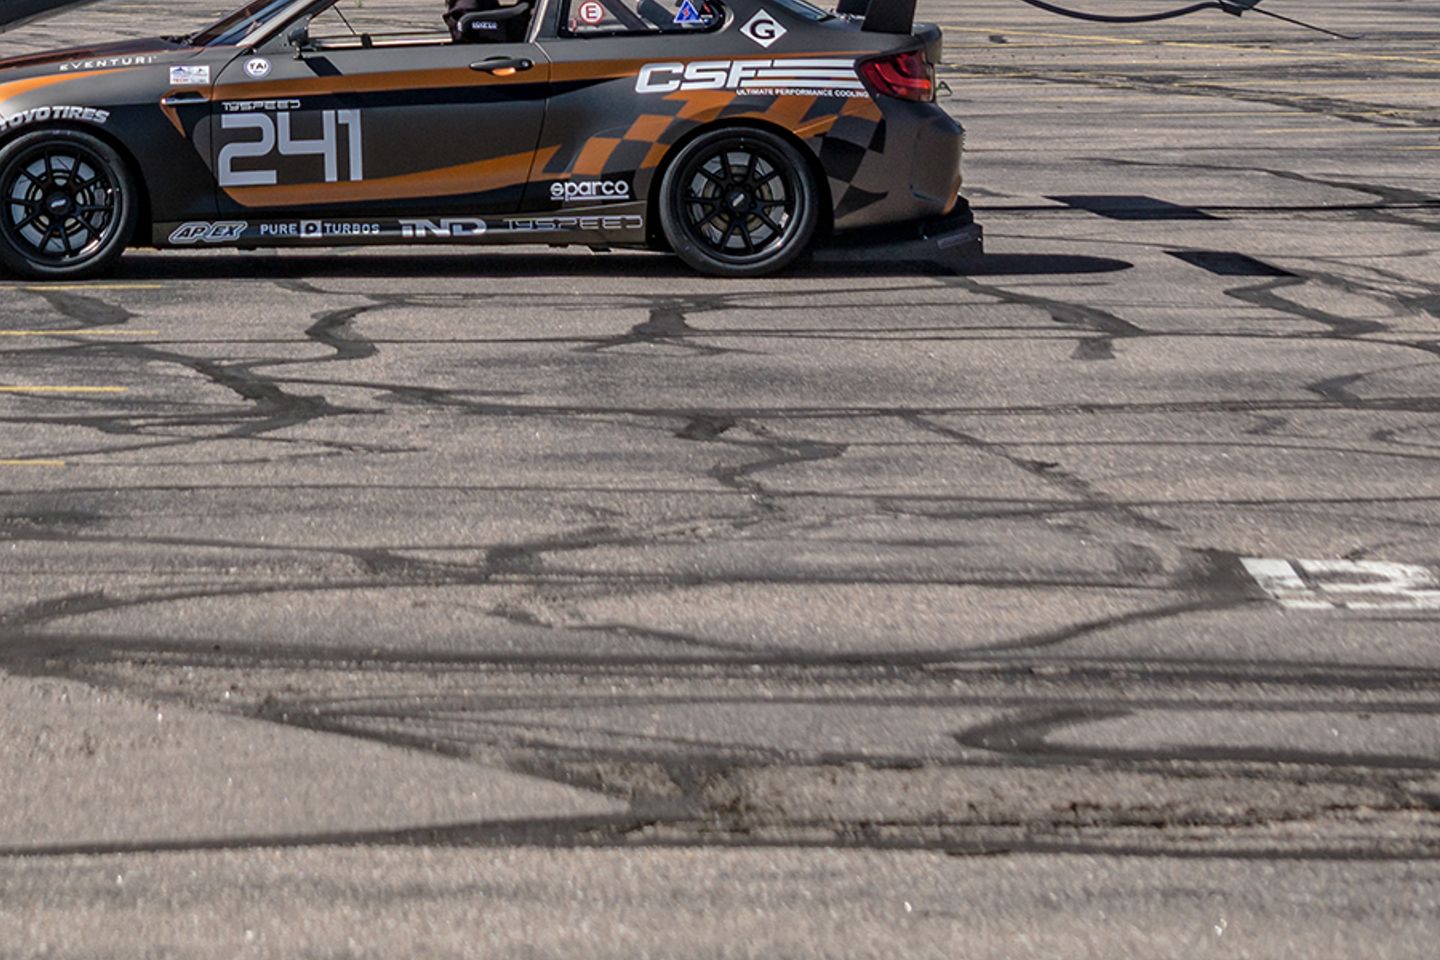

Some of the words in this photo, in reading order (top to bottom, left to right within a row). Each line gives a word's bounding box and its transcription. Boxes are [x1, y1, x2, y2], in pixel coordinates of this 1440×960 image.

[585, 5, 597, 19] E
[749, 19, 777, 40] G
[59, 56, 153, 71] EVENTURI
[635, 59, 771, 94] CSF
[736, 87, 774, 96] ULTIMATE
[775, 88, 833, 97] PERFORMANCE
[834, 89, 869, 99] COOLING
[0, 107, 51, 131] TOYO
[52, 105, 110, 124] TIRES
[218, 109, 363, 187] 241
[550, 180, 629, 201] sparco
[260, 223, 297, 235] PURE
[324, 222, 381, 235] TURBOS
